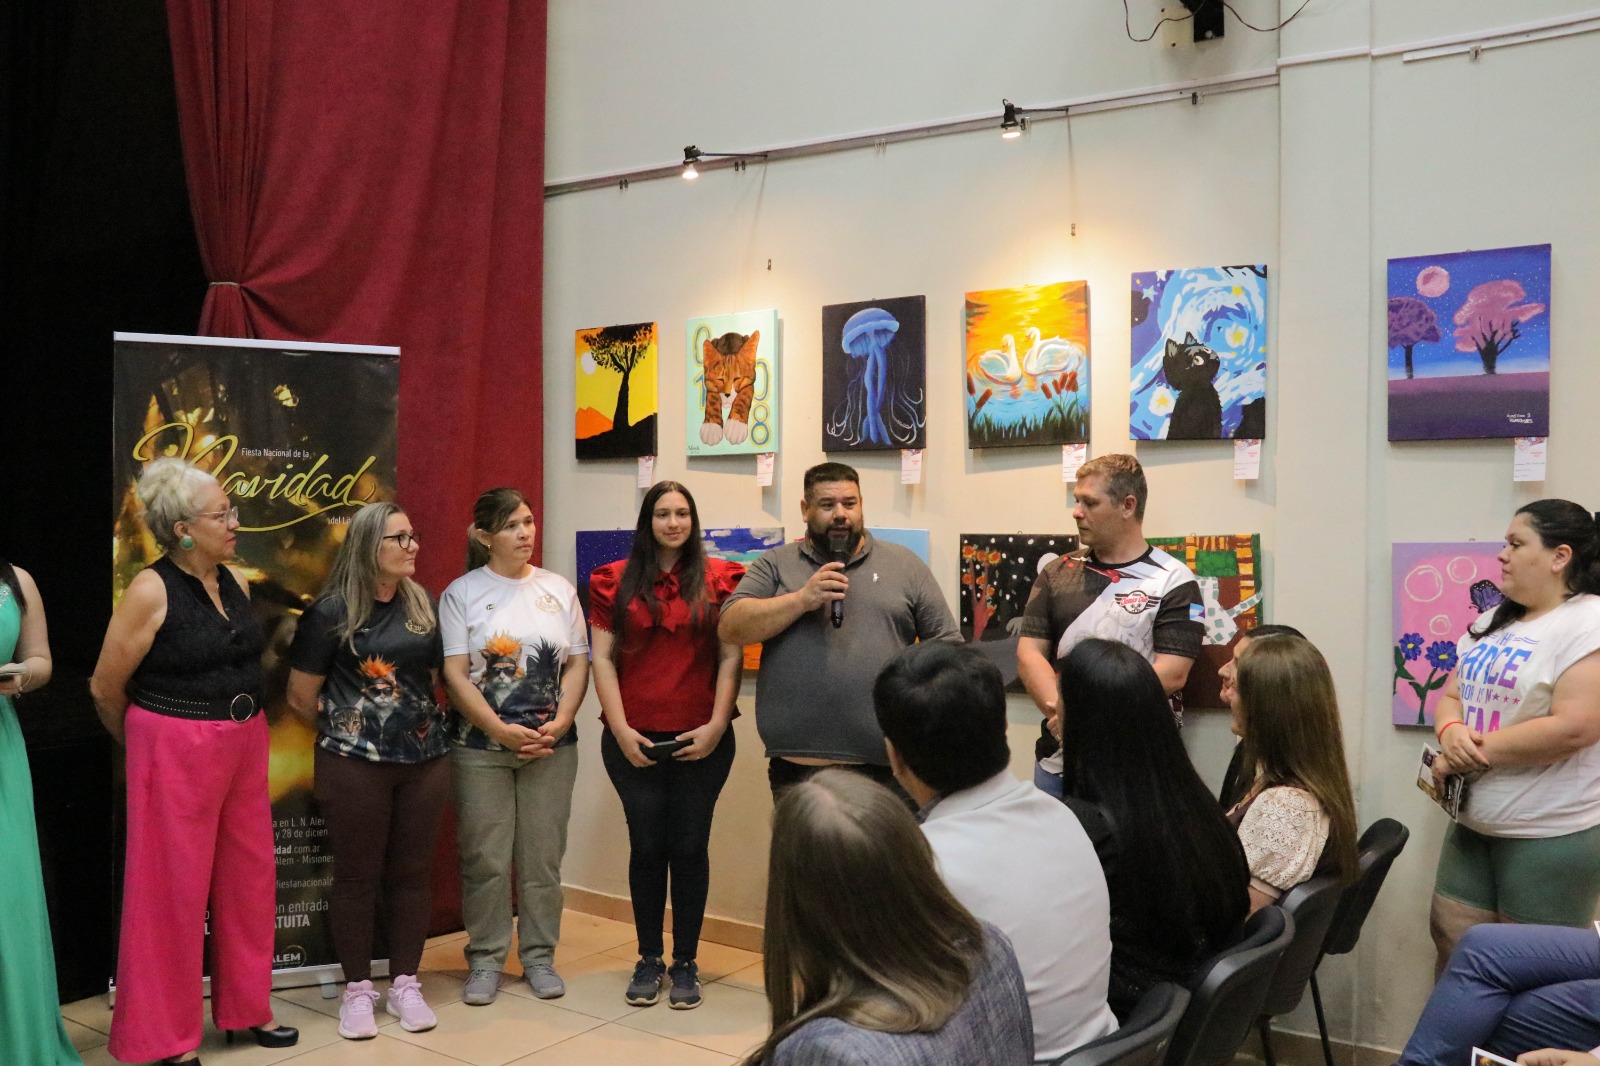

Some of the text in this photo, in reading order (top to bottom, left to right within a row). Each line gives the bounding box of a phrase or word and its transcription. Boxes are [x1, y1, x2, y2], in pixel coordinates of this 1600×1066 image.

[241, 447, 310, 458] Fiesta Nacional de la
[132, 422, 376, 507] Navidad
[279, 820, 290, 828] en
[275, 830, 280, 841] y
[282, 829, 292, 839] 28
[293, 829, 304, 838] de
[288, 899, 329, 912] entrada
